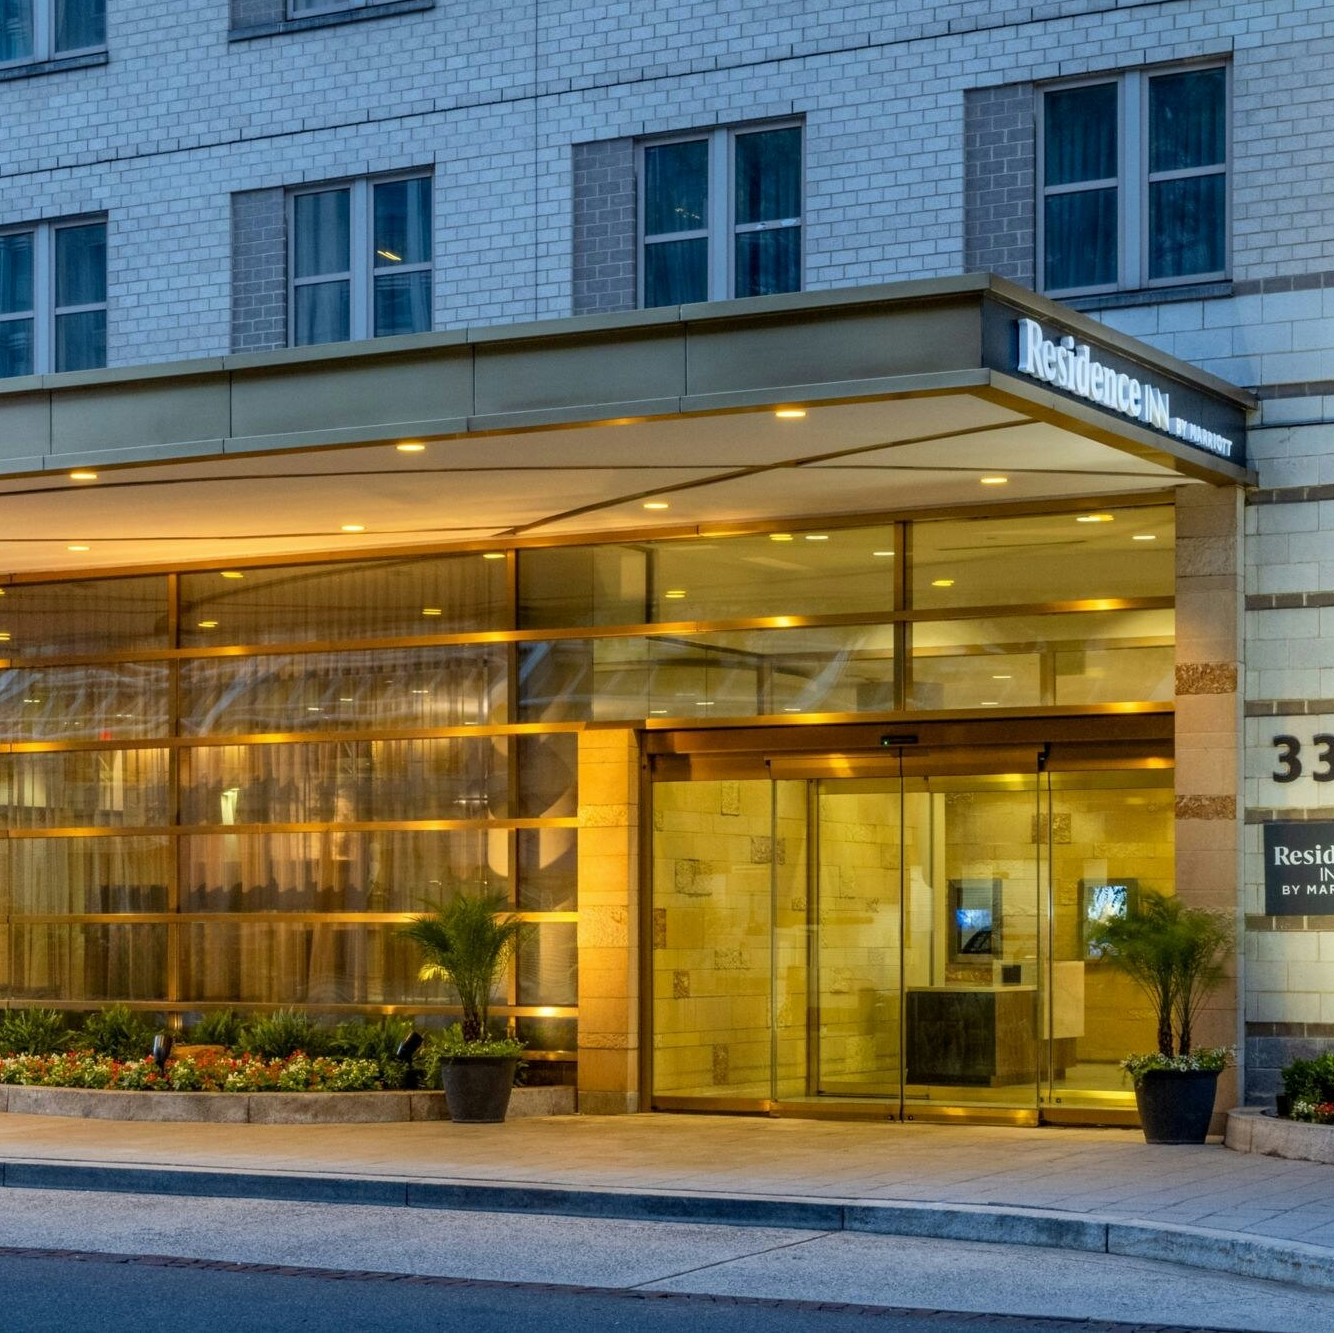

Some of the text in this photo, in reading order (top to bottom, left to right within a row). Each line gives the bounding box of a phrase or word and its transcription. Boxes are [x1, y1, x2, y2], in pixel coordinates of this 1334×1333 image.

[1018, 317, 1142, 417] Residence
[1170, 417, 1188, 439] BY
[1186, 423, 1233, 457] MARRIOTT
[1282, 885, 1300, 895] BY
